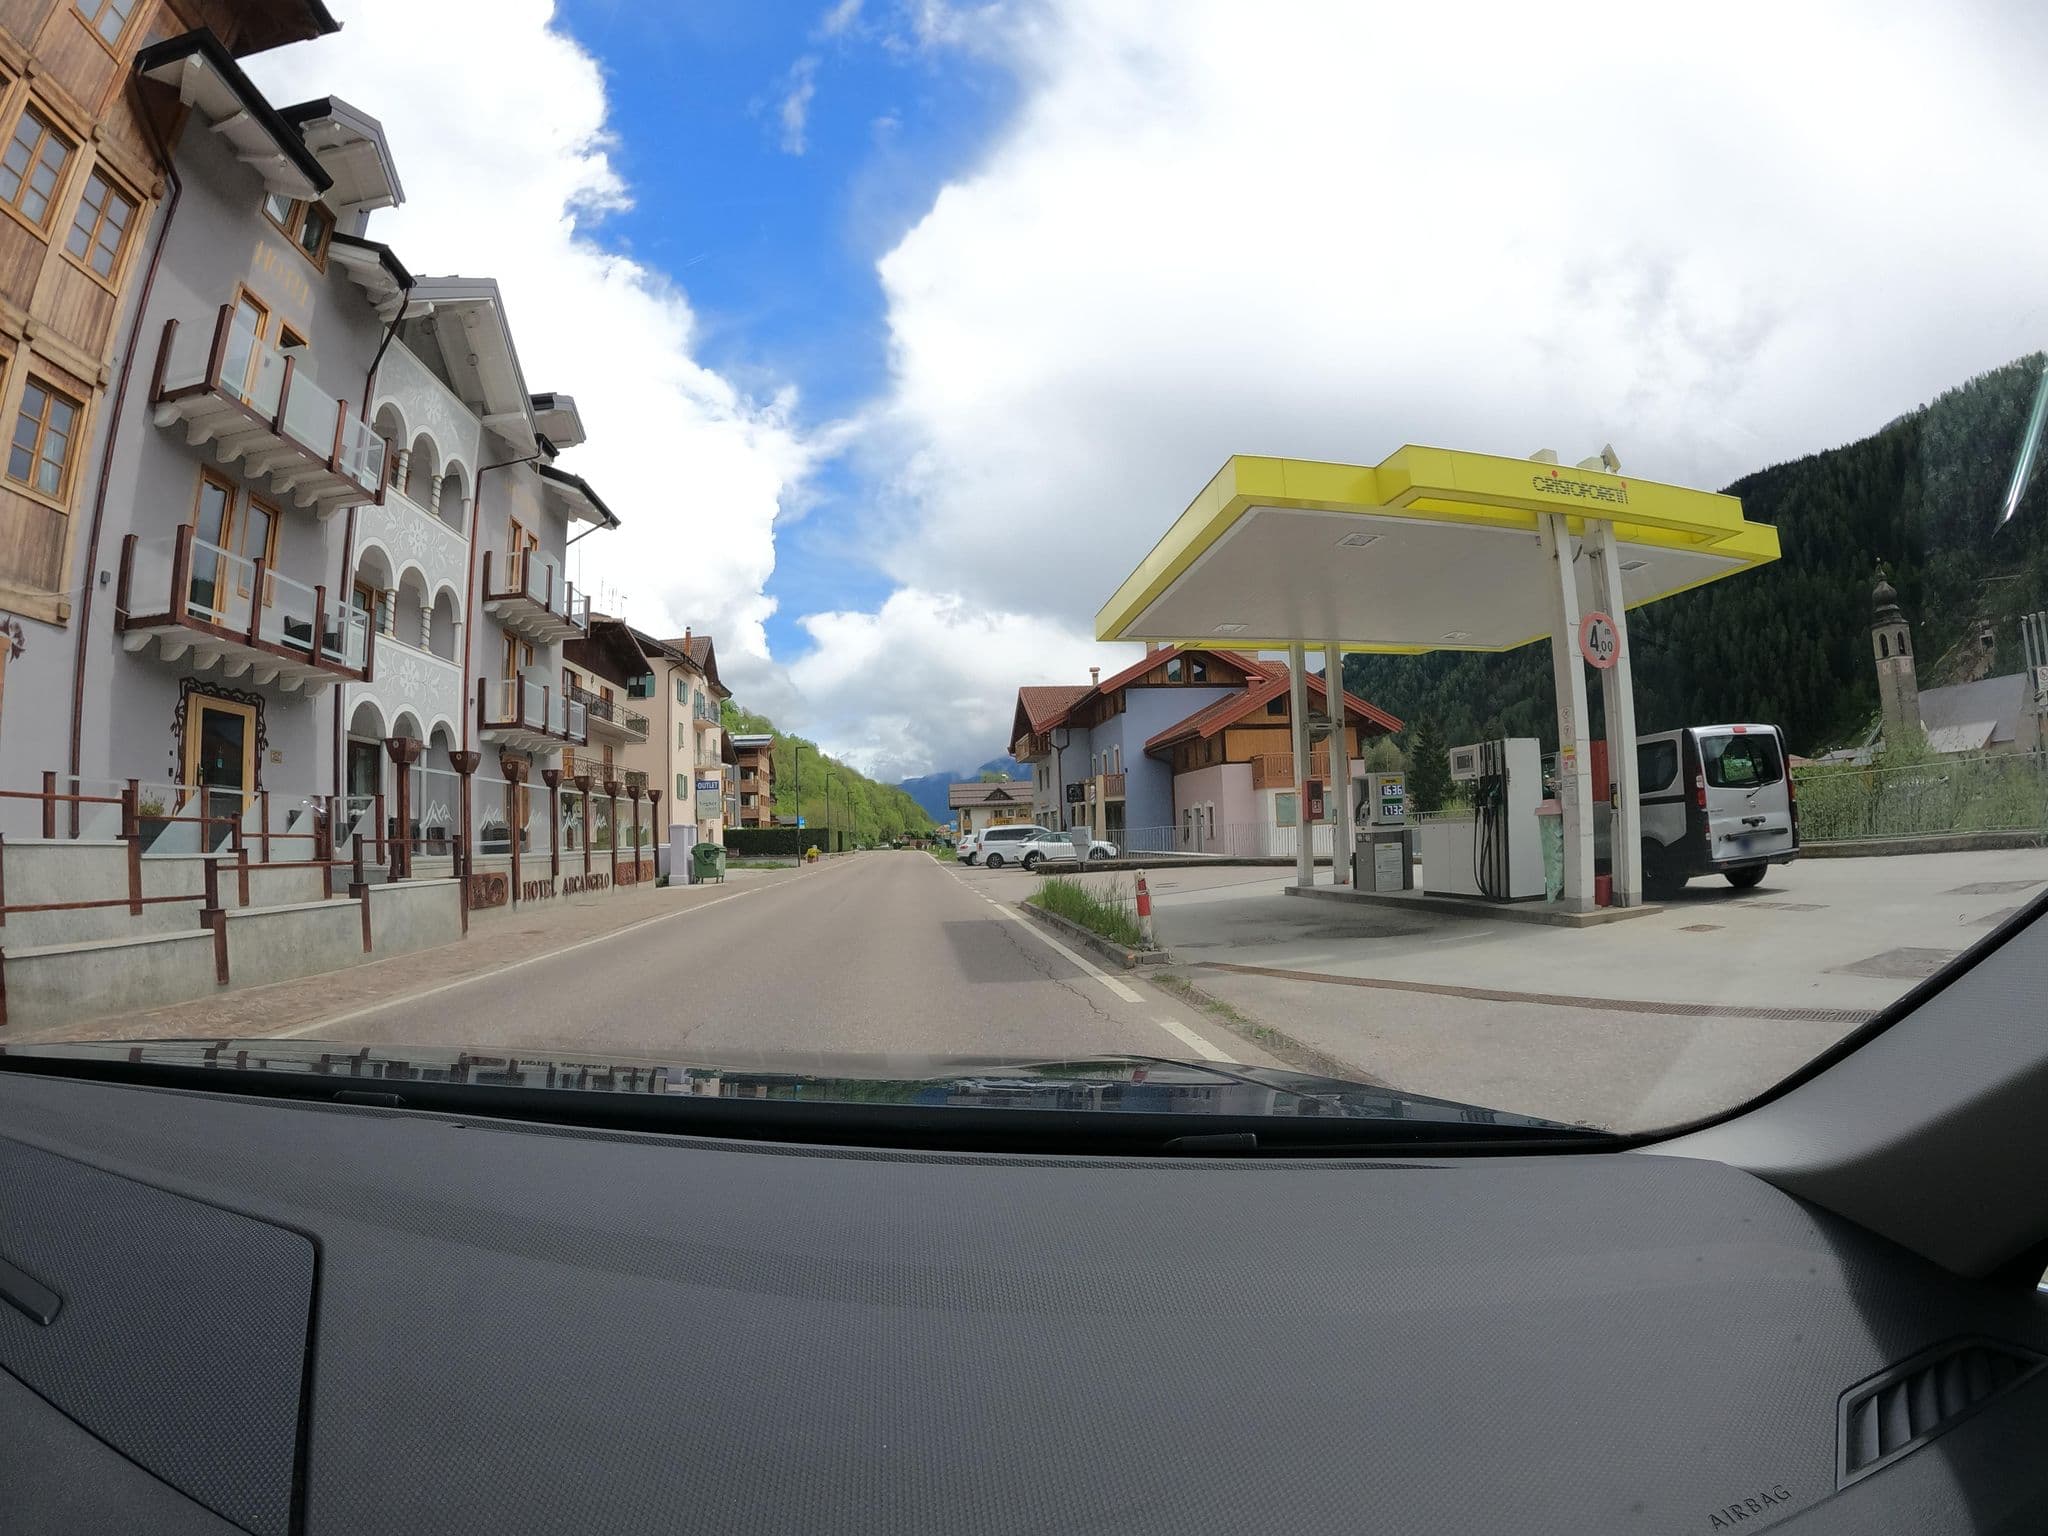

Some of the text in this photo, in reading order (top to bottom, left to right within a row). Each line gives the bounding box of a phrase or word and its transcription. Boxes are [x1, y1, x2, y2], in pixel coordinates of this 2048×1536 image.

[697, 781, 719, 789] OUTLET
[523, 873, 610, 902] HOTEL ARCANGELO
[1708, 1484, 1792, 1532] AIRBAG
